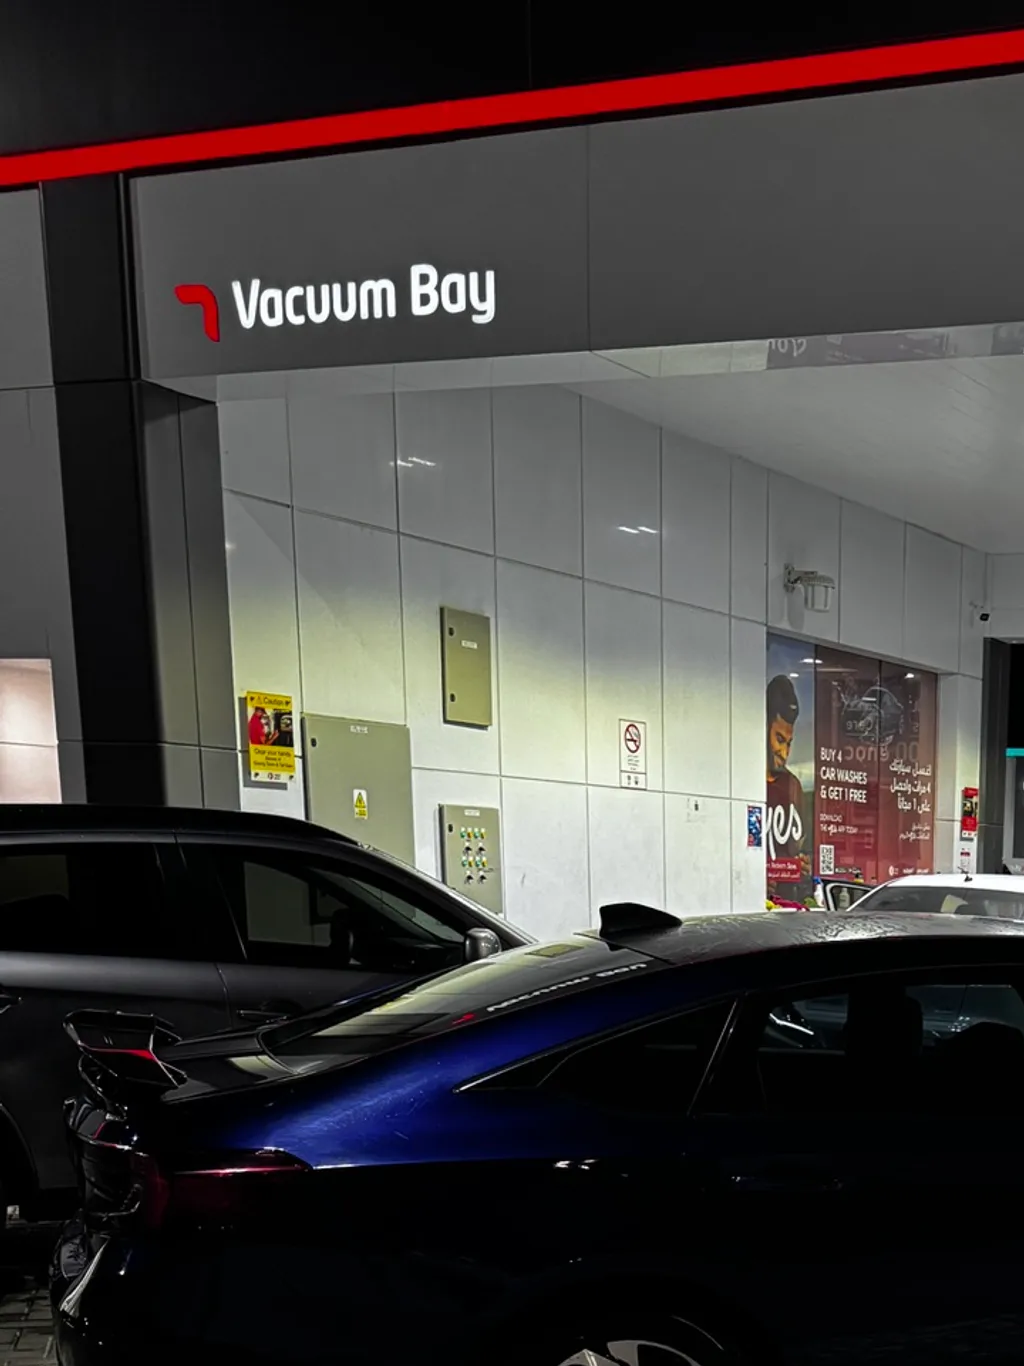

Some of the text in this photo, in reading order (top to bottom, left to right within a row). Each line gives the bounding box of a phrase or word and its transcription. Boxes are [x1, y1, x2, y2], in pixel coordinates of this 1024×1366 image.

[231, 263, 496, 329] Vacuum Bay
[821, 747, 843, 763] BUY 4
[820, 766, 867, 785] CAR WASHES
[820, 785, 827, 799] &
[828, 786, 843, 800] GET
[849, 788, 867, 804] FREE
